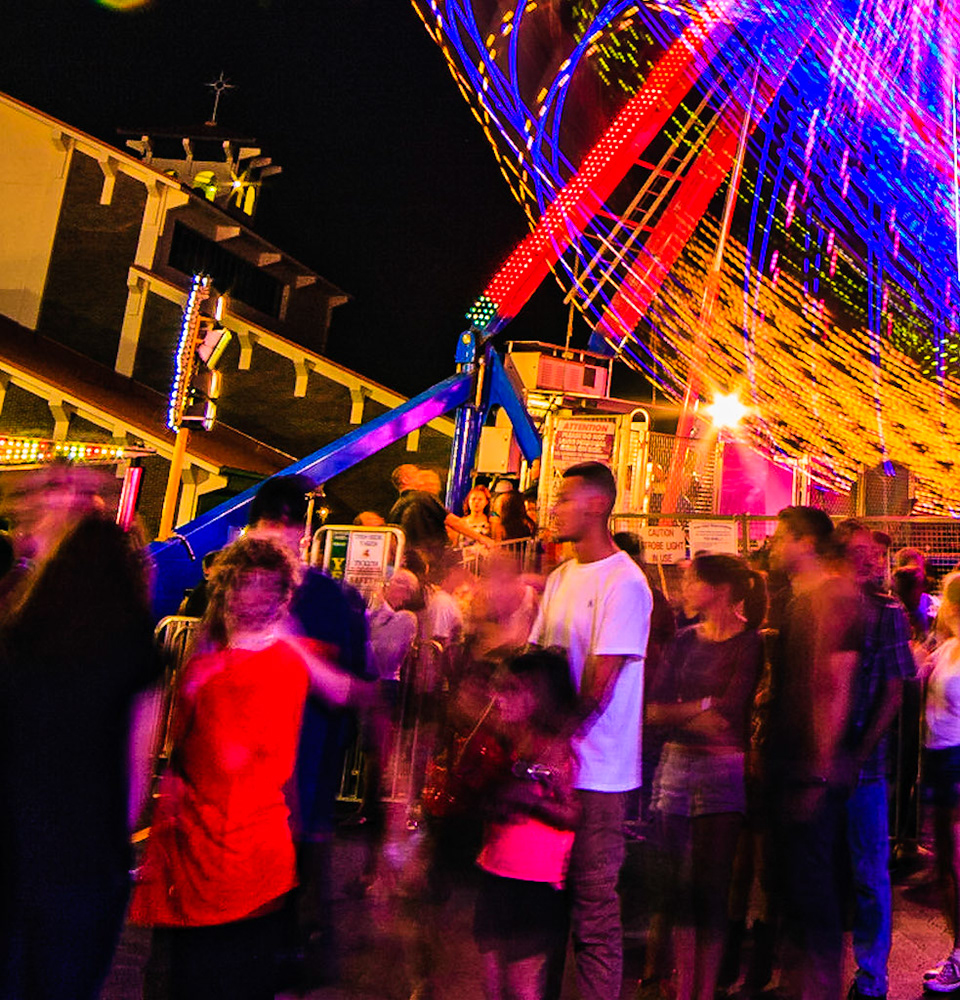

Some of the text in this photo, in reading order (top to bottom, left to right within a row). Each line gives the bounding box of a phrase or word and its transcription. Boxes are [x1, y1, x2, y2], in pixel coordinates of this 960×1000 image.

[563, 422, 609, 432] ATTENTION
[647, 528, 674, 537] CAUTION
[666, 541, 684, 550] LIGHT
[660, 554, 672, 562] USE
